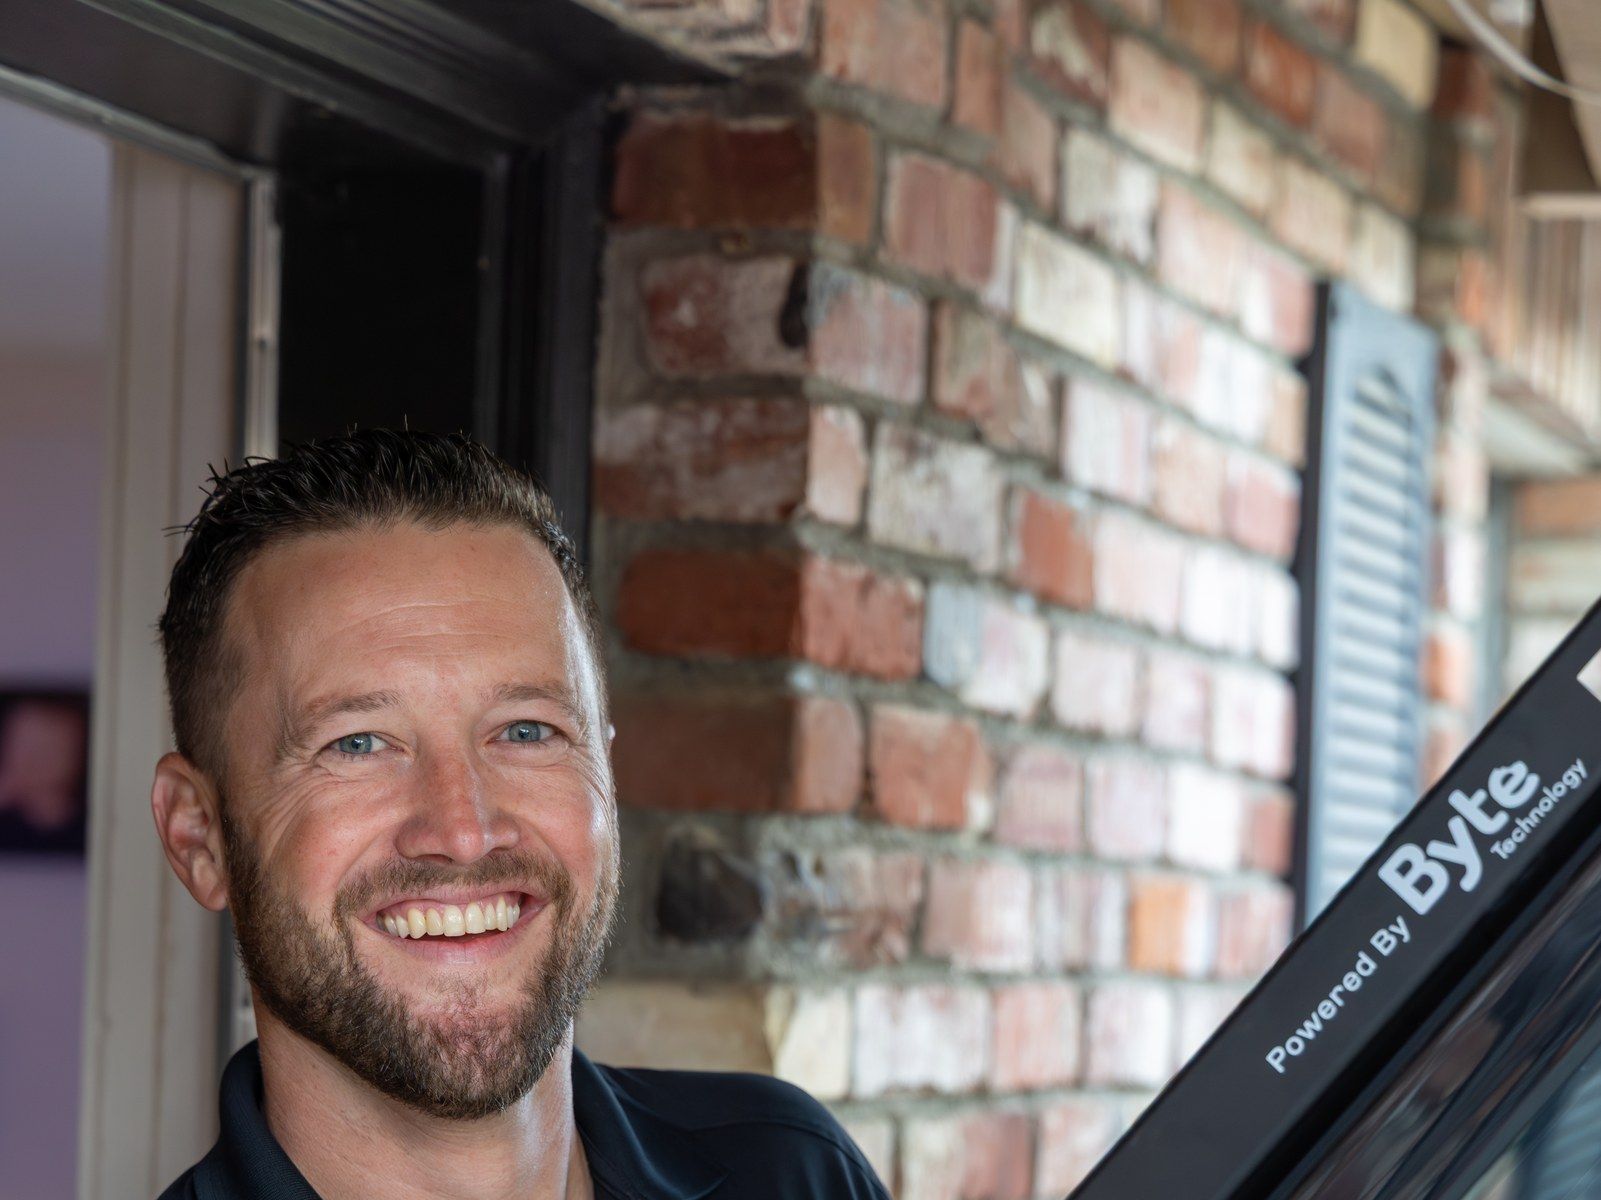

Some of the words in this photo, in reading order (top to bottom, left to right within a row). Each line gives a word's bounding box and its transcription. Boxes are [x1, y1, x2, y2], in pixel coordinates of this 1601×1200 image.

[1378, 760, 1541, 916] Byte
[1490, 758, 1589, 860] Technology
[1369, 915, 1412, 957] By
[1265, 951, 1378, 1074] Powered
